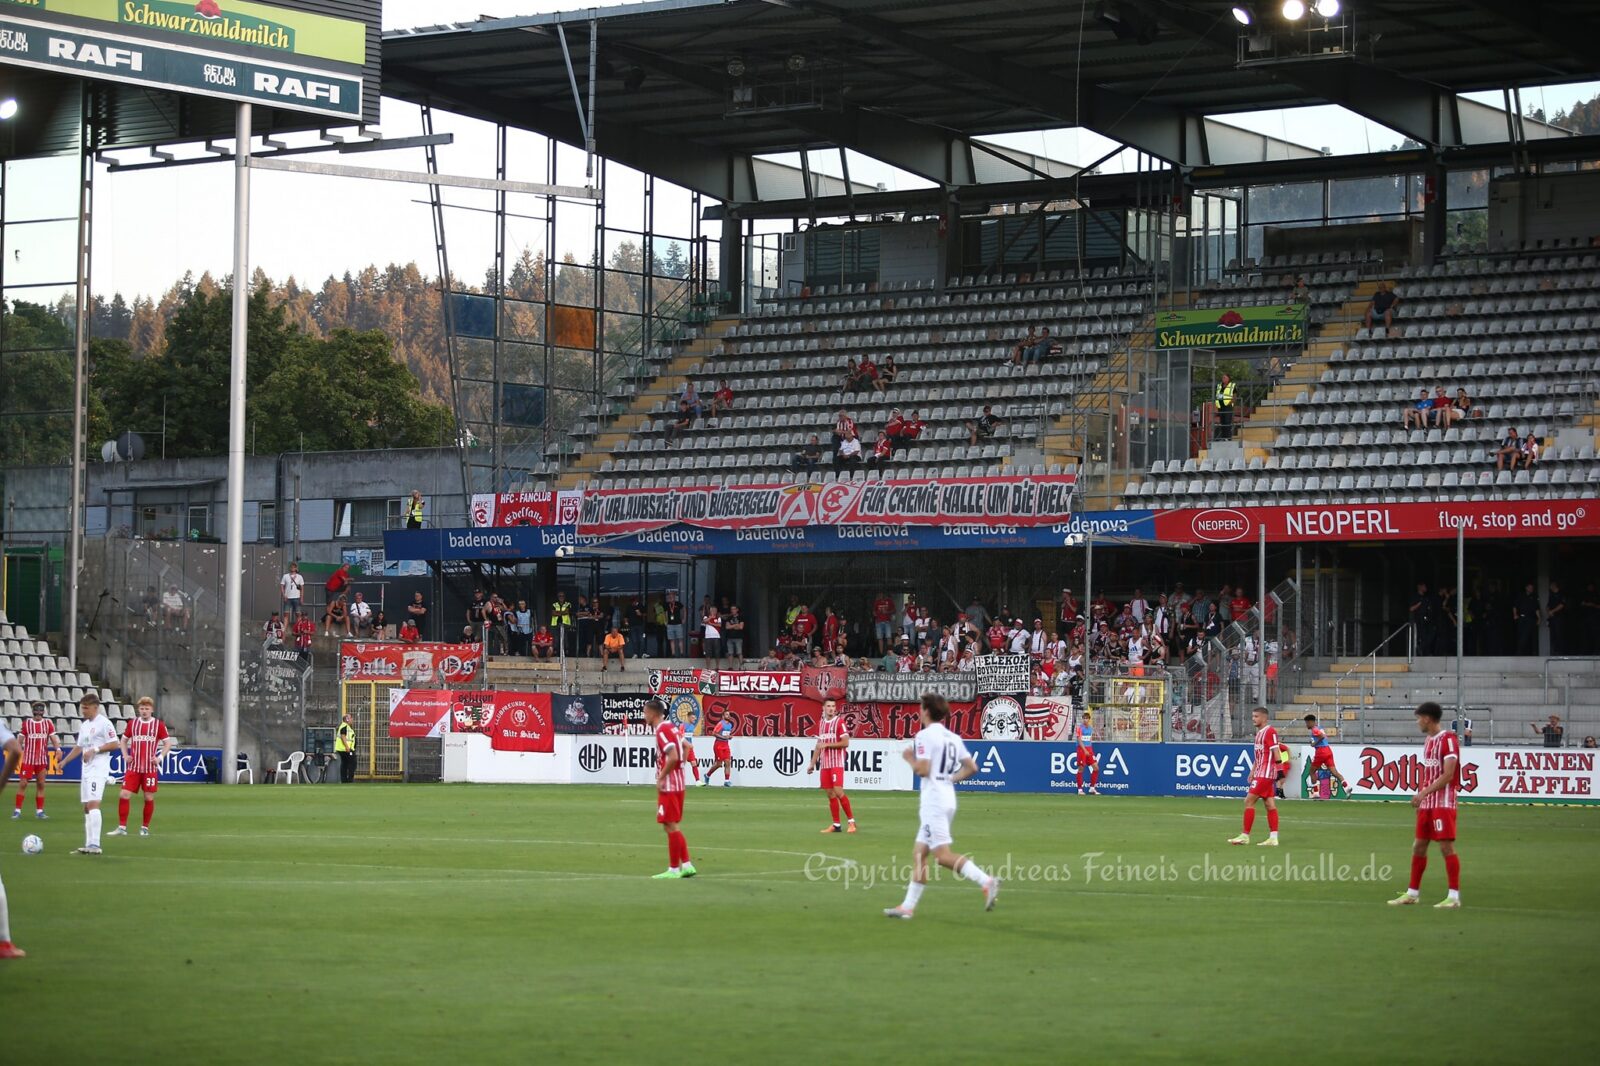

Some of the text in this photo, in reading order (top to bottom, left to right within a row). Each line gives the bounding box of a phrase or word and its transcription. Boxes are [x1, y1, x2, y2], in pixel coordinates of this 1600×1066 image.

[124, 1, 289, 49] Schwarzwaldmilch
[0, 29, 14, 41] ET
[0, 39, 29, 52] OUCH
[48, 37, 143, 71] RAFI
[203, 63, 235, 78] GET IN
[204, 73, 236, 87] TOUCH
[254, 72, 340, 104] RAFI
[1159, 324, 1303, 347] Schwarzwaldmilch
[500, 493, 515, 504] HFC
[519, 491, 552, 503] FANCLUB
[681, 491, 707, 518] UND
[708, 486, 780, 518] BÜRGERGELD
[859, 481, 887, 513] FÜR
[942, 483, 984, 514] HALLE
[987, 484, 1010, 514] UM
[1053, 517, 1128, 534] badenova
[1286, 510, 1399, 536] NEOPERL
[1438, 511, 1478, 530] flow,
[1482, 512, 1517, 531] stop
[1522, 510, 1552, 527] and
[449, 532, 512, 548] badenova
[637, 528, 704, 543] badenova
[736, 526, 805, 541] badenova
[838, 524, 909, 539] badenova
[663, 675, 699, 684] MANSFELD
[719, 674, 801, 693] SURREALE
[578, 743, 607, 771] AHP
[773, 745, 804, 774] AHP
[939, 741, 957, 775] 19
[1176, 754, 1229, 777] BGV
[1495, 752, 1595, 771] TANNEN
[91, 782, 97, 792] 9
[854, 776, 882, 785] BEWEGT
[1499, 771, 1592, 795] ZÄPFLE
